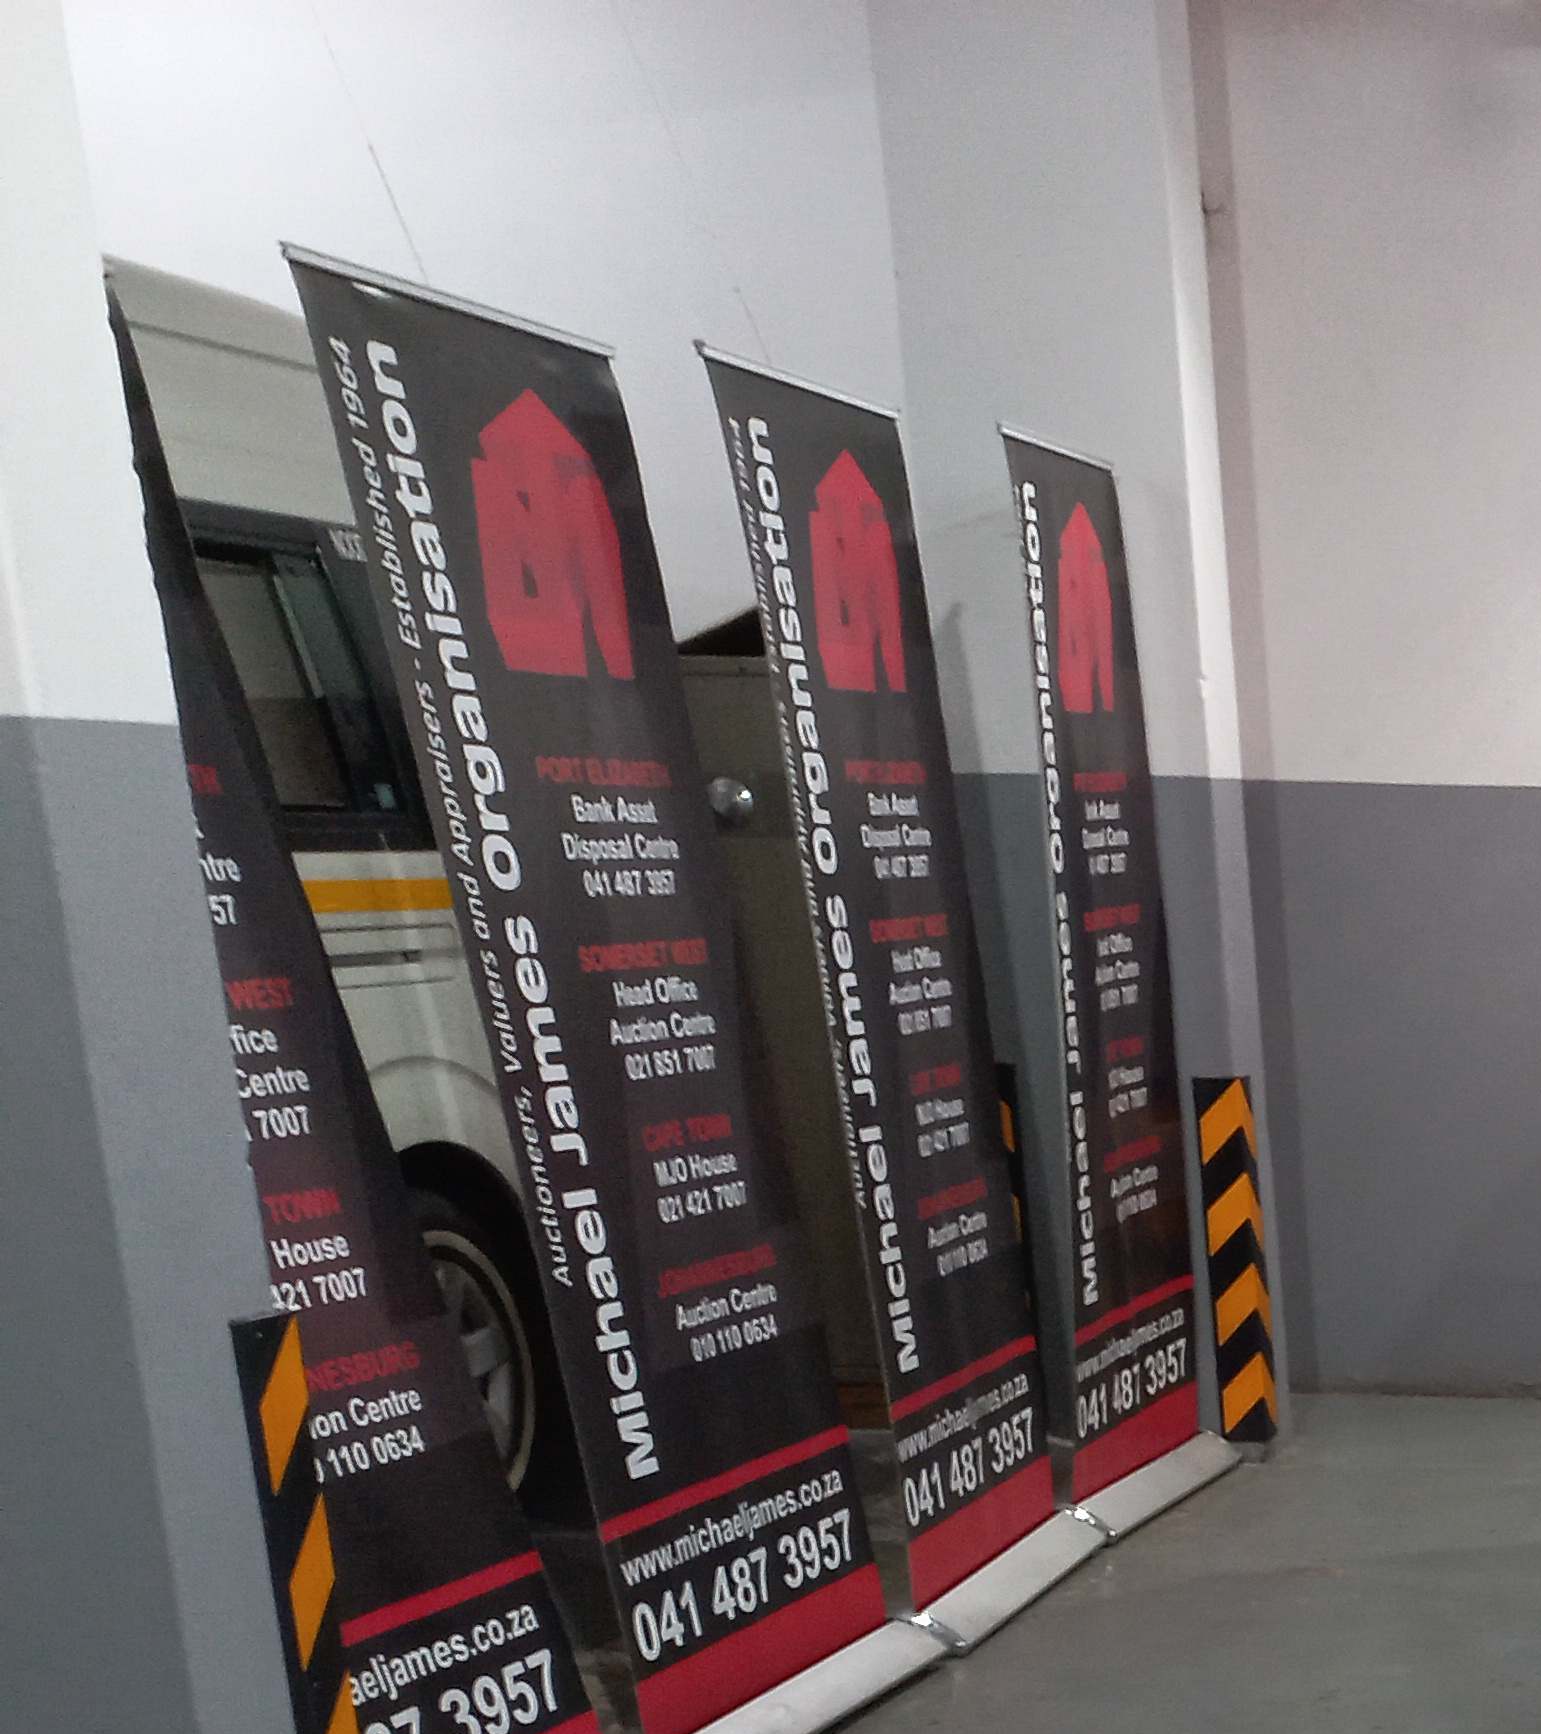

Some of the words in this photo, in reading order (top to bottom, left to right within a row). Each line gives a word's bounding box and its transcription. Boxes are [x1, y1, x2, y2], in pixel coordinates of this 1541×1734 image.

[328, 335, 368, 429] 1964
[352, 436, 422, 650] Established
[366, 338, 523, 891] Organisation
[748, 416, 838, 875] Organisation
[414, 679, 474, 866] Appraisers
[457, 871, 491, 940] and
[480, 948, 523, 1073] Valuers
[504, 914, 589, 1167] James
[825, 895, 877, 1107] James
[252, 1105, 310, 1140] 7007
[688, 1154, 737, 1178] House
[514, 1085, 573, 1288] Auctioneers,
[270, 1236, 350, 1269] House
[312, 1267, 366, 1304] 7007
[858, 1124, 920, 1374] Michael
[561, 1187, 661, 1481] Michael
[1077, 1383, 1108, 1439] 041
[1112, 1363, 1142, 1416] 487
[1144, 1338, 1187, 1396] 3957
[327, 1441, 370, 1477] 110
[371, 1425, 425, 1464] 0634
[348, 1389, 422, 1426] Centre
[904, 1461, 946, 1528] 041
[950, 1436, 984, 1498] 487
[987, 1406, 1034, 1475] 3957
[620, 1467, 843, 1587] www.michaeljames.co.za
[632, 1580, 702, 1663] 041
[712, 1546, 768, 1622] 487
[777, 1508, 853, 1591] 3957
